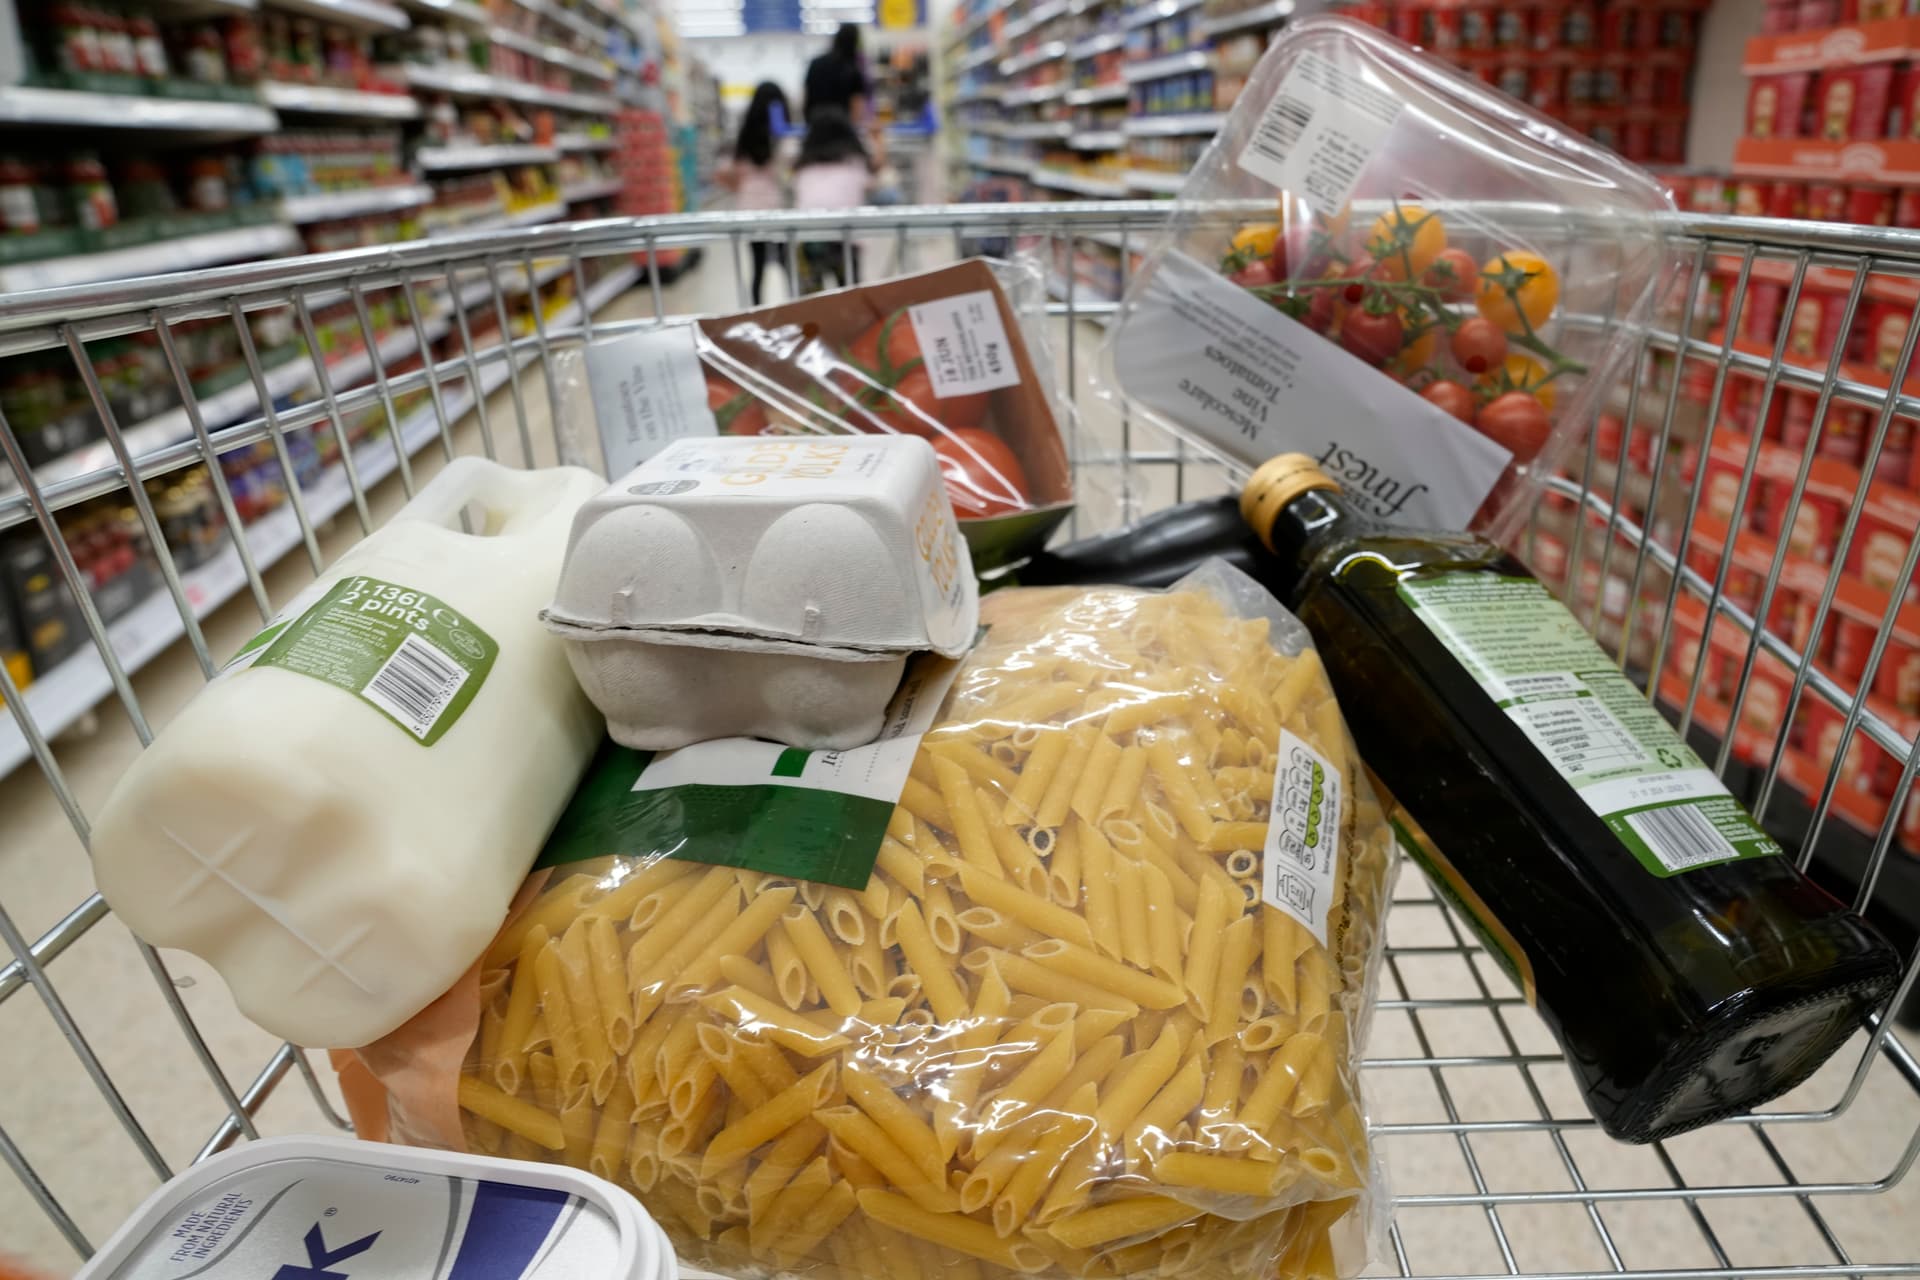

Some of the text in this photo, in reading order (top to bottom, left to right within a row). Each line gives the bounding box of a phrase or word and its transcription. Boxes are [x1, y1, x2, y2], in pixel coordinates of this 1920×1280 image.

[1201, 344, 1279, 404] Tomatoes
[1177, 379, 1260, 440] Mescolare
[1229, 387, 1269, 423] Vine
[1312, 441, 1429, 517] finest
[339, 591, 430, 631] 2 pints
[354, 580, 428, 613] 1.136L
[170, 1191, 245, 1263] FROM NATURAL
[172, 1210, 207, 1240] MADE
[191, 1198, 255, 1261] INGREDIENTS
